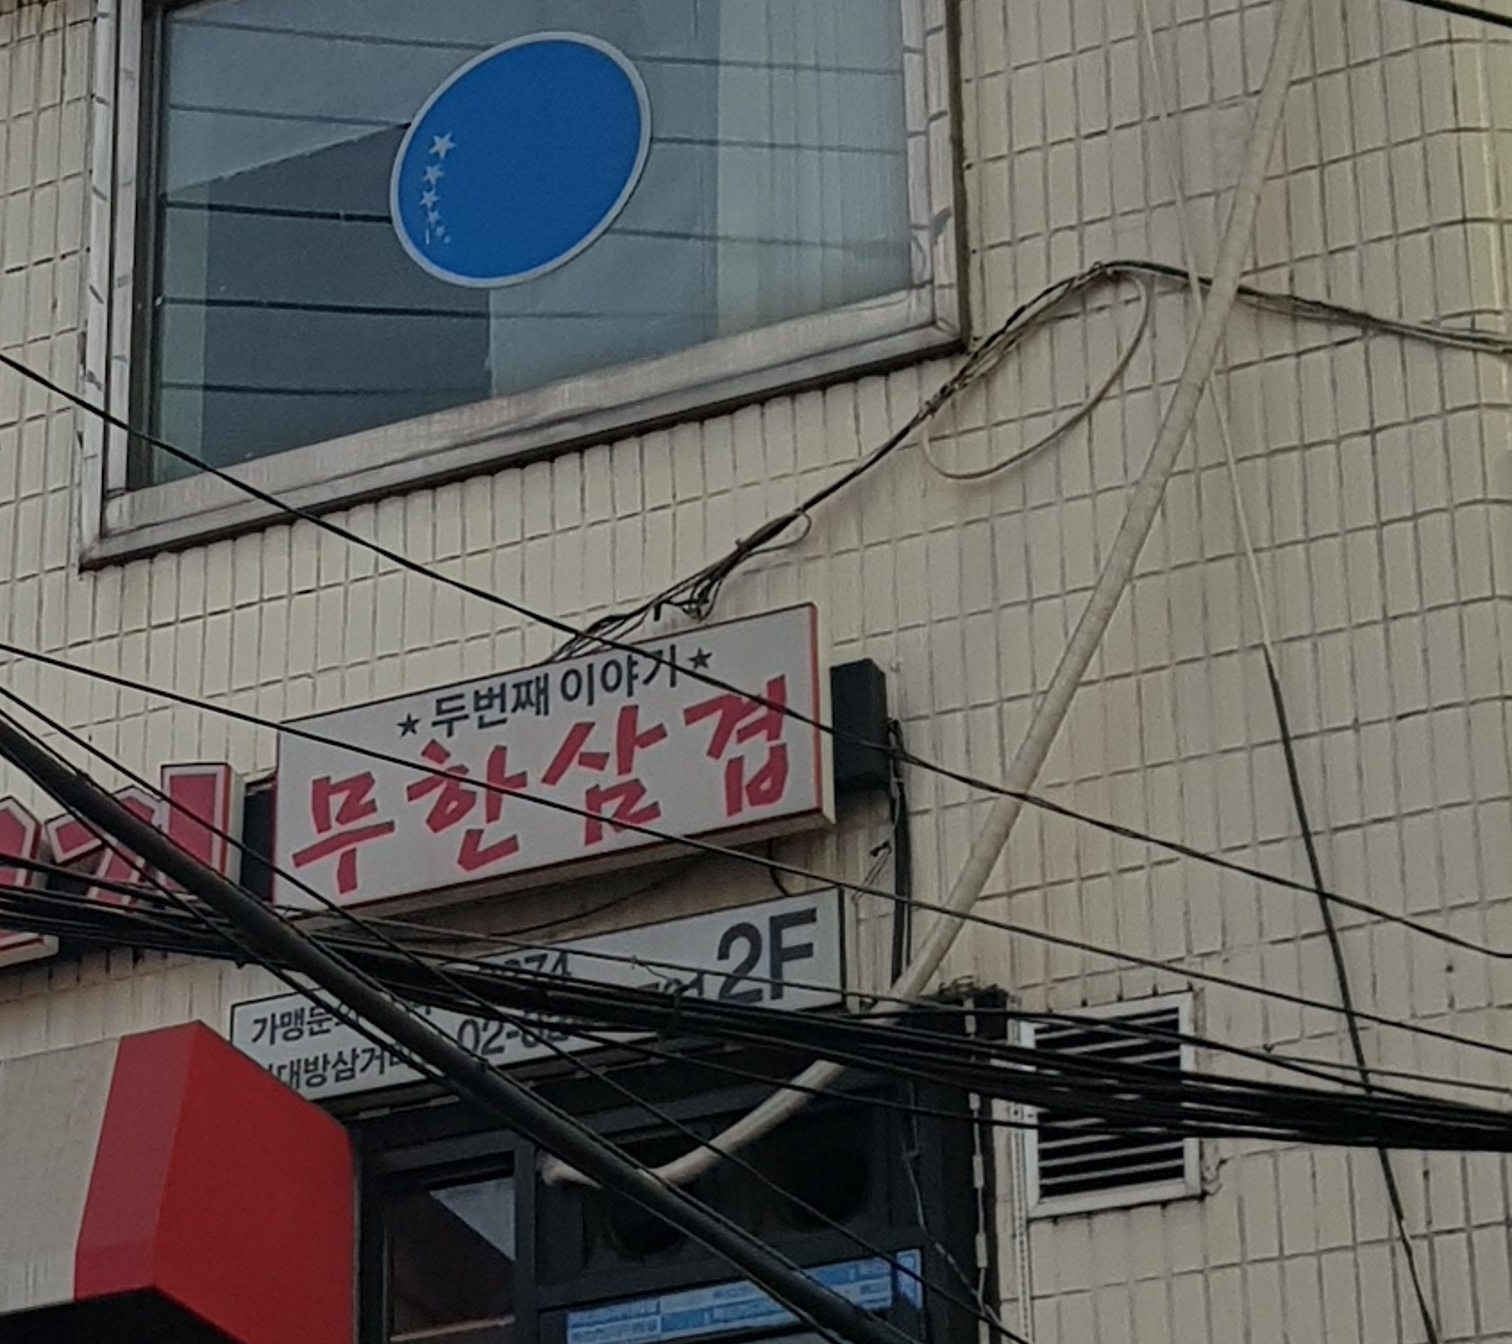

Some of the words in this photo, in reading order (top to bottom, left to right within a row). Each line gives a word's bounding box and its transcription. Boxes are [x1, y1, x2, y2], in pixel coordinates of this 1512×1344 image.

[292, 675, 790, 894] 무한삼겹
[717, 907, 817, 1004] 2F
[252, 1002, 352, 1046] 가맹문
